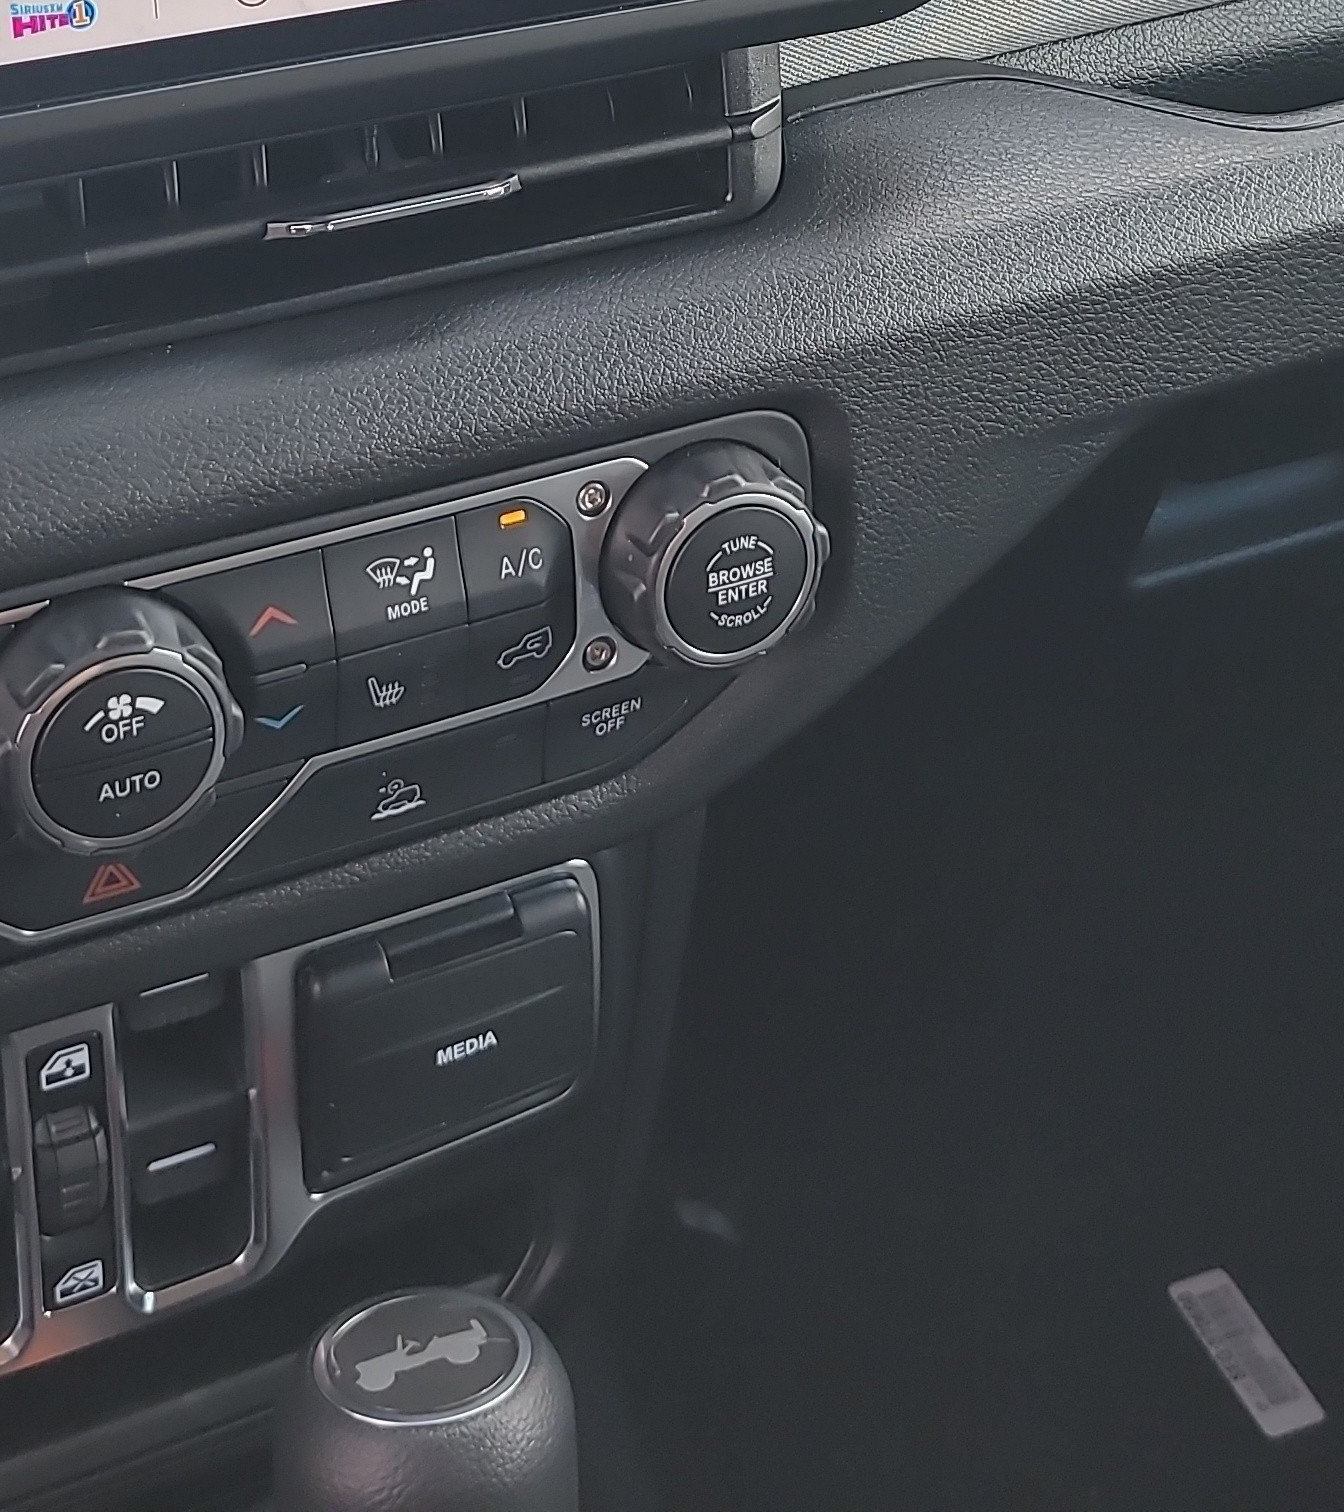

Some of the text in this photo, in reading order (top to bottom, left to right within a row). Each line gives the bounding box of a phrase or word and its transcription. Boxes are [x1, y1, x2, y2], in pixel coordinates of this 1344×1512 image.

[70, 0, 92, 27] 1
[721, 535, 758, 555] TUNE
[500, 547, 544, 580] A/C
[708, 557, 773, 587] BROWSE
[718, 579, 768, 606] ENTER
[386, 596, 429, 621] MODE
[717, 605, 768, 627] SCROLL
[581, 696, 642, 727] SCREEN
[101, 715, 145, 743] OFF
[595, 715, 626, 736] OFF
[98, 770, 161, 803] AUTO
[436, 1030, 498, 1066] MEDIA
